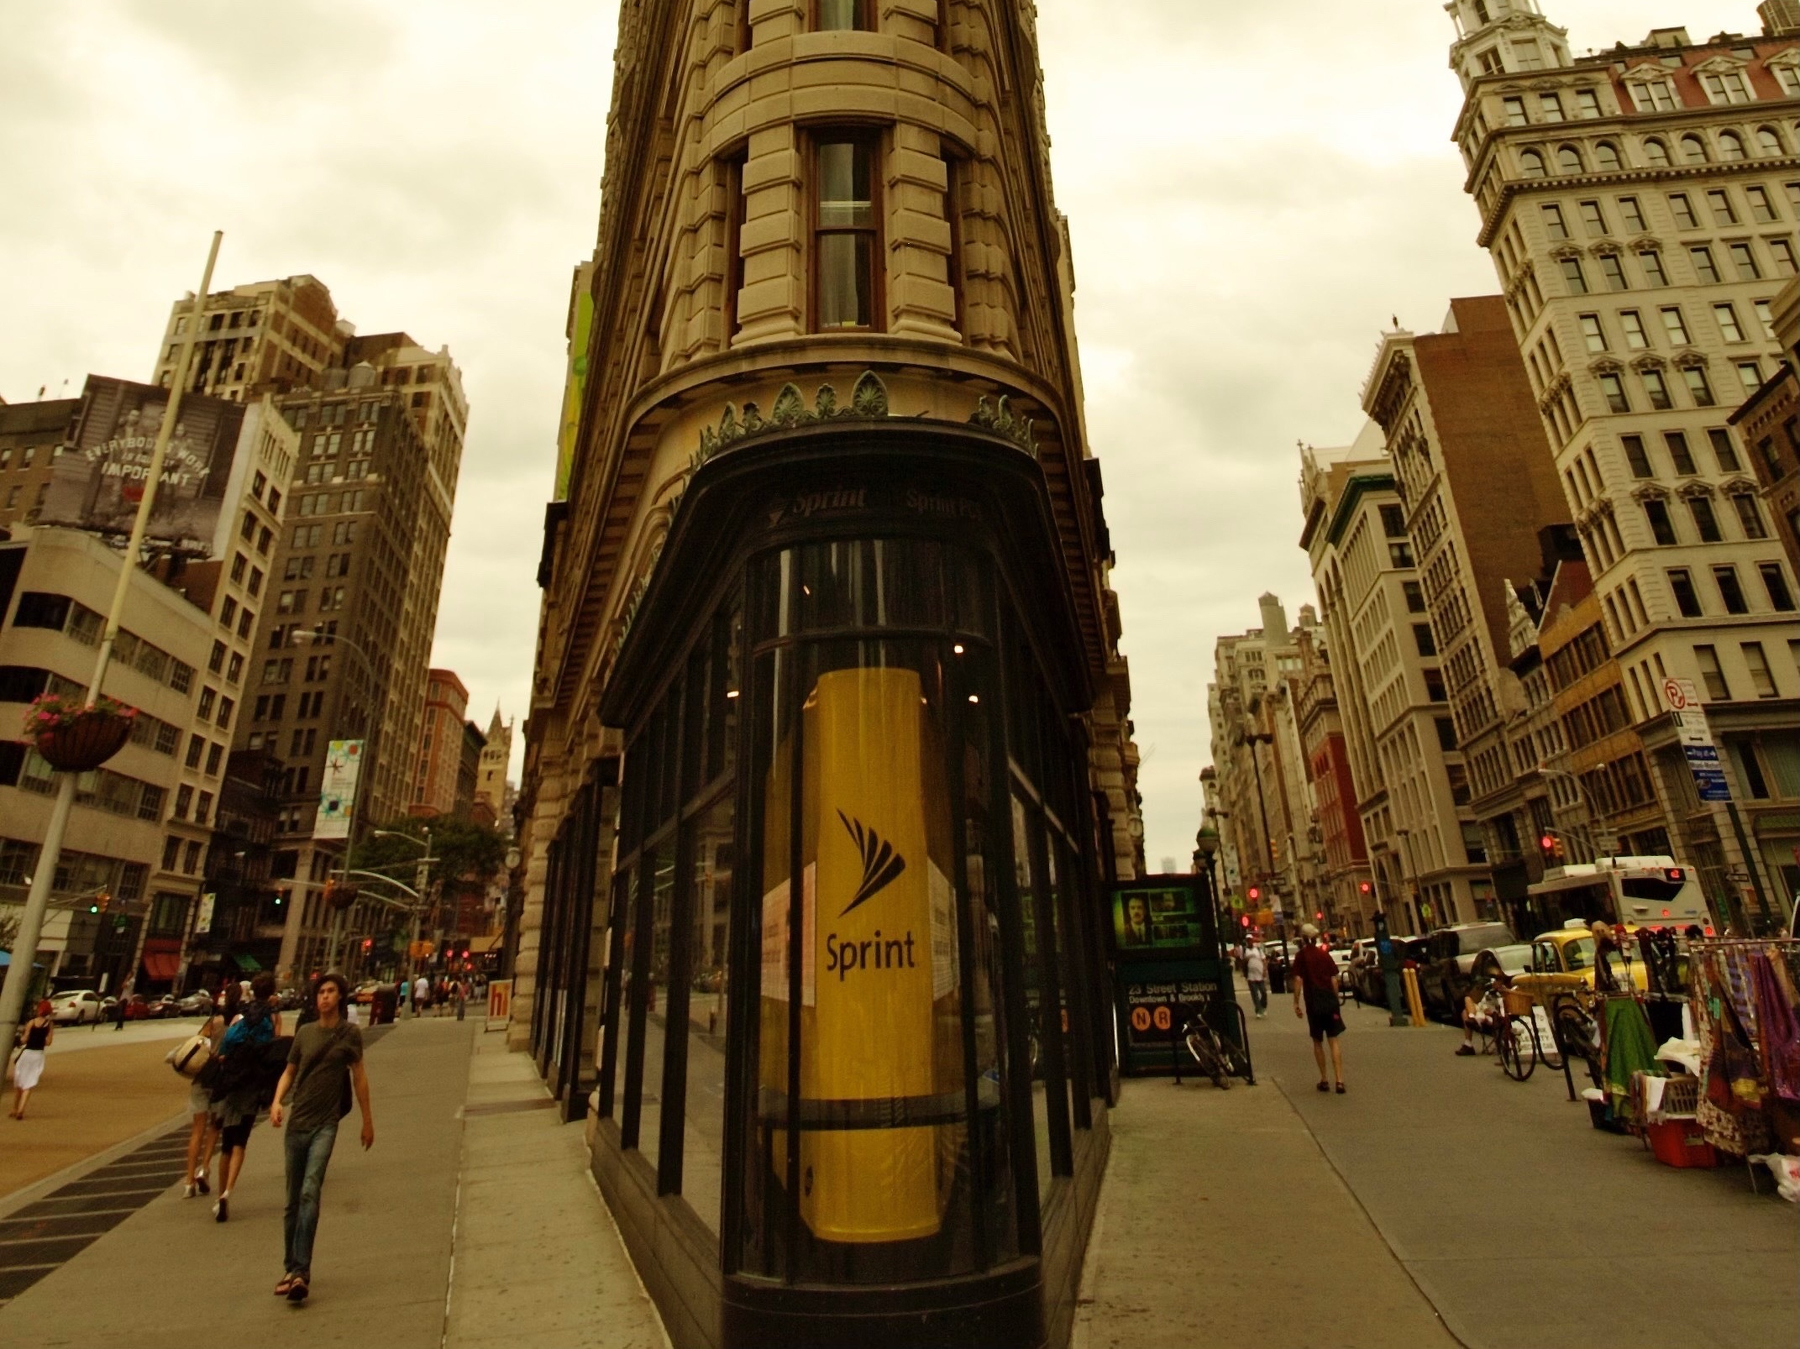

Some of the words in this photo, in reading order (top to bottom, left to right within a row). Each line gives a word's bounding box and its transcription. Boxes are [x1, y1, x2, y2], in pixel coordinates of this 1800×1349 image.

[101, 461, 191, 487] IMPORANT
[177, 449, 210, 479] WORK
[792, 487, 867, 517] Sprint
[827, 930, 915, 982] Sprint
[1129, 984, 1142, 995] 23
[1146, 982, 1177, 994] Street
[1181, 981, 1218, 993] Station
[1129, 995, 1168, 1004] Downtown
